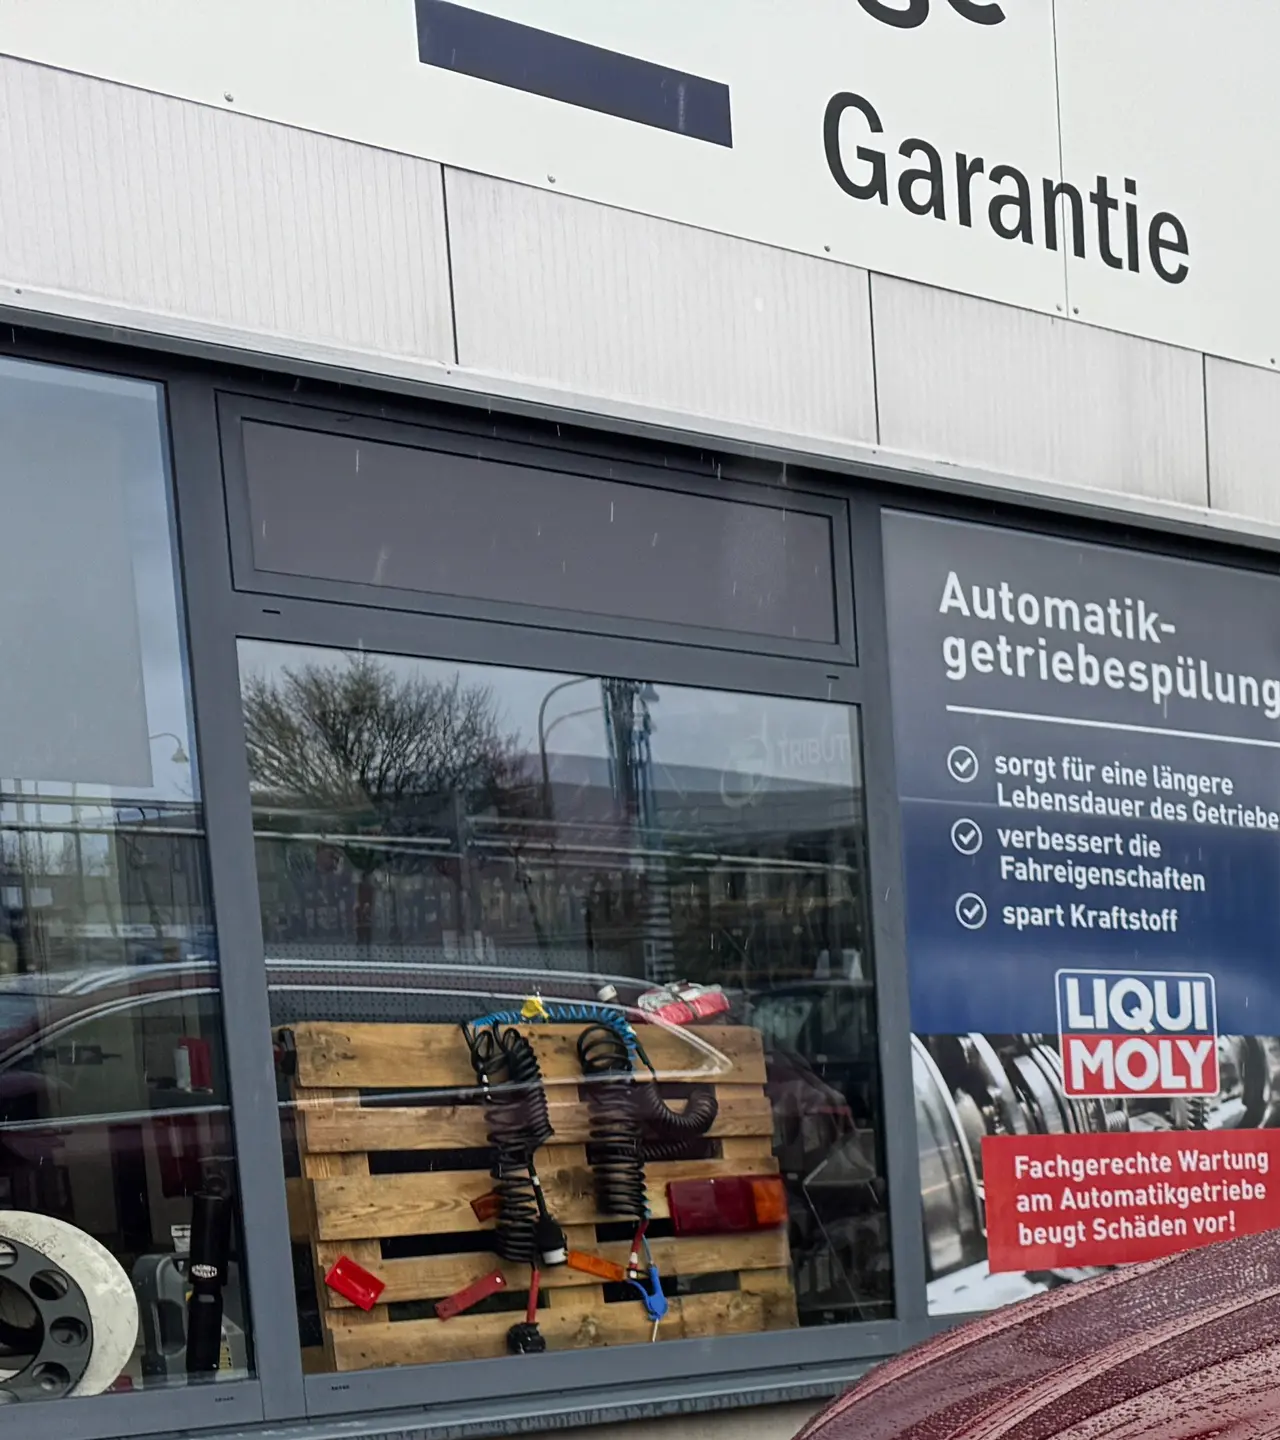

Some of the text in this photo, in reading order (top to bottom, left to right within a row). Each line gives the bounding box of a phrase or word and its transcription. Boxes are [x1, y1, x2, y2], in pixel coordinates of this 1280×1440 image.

[823, 91, 1190, 284] Garantie
[938, 571, 1176, 643] Automatik-
[994, 753, 1234, 798] sorgt für eine längere
[997, 784, 1144, 818] Lebensdauer
[1150, 797, 1188, 821] des
[998, 827, 1162, 858] verbessert die
[1000, 856, 1206, 892] Fahreigenschaften
[1003, 903, 1179, 932] spart Kraftstoff
[1065, 977, 1208, 1034] LIQUI
[1069, 1038, 1214, 1091] MOLY
[1014, 1148, 1269, 1182] Fachgerechte Wartung
[1016, 1181, 1266, 1213] am Automatikgetriebe
[1019, 1210, 1236, 1249] beugt Schäden vor!
